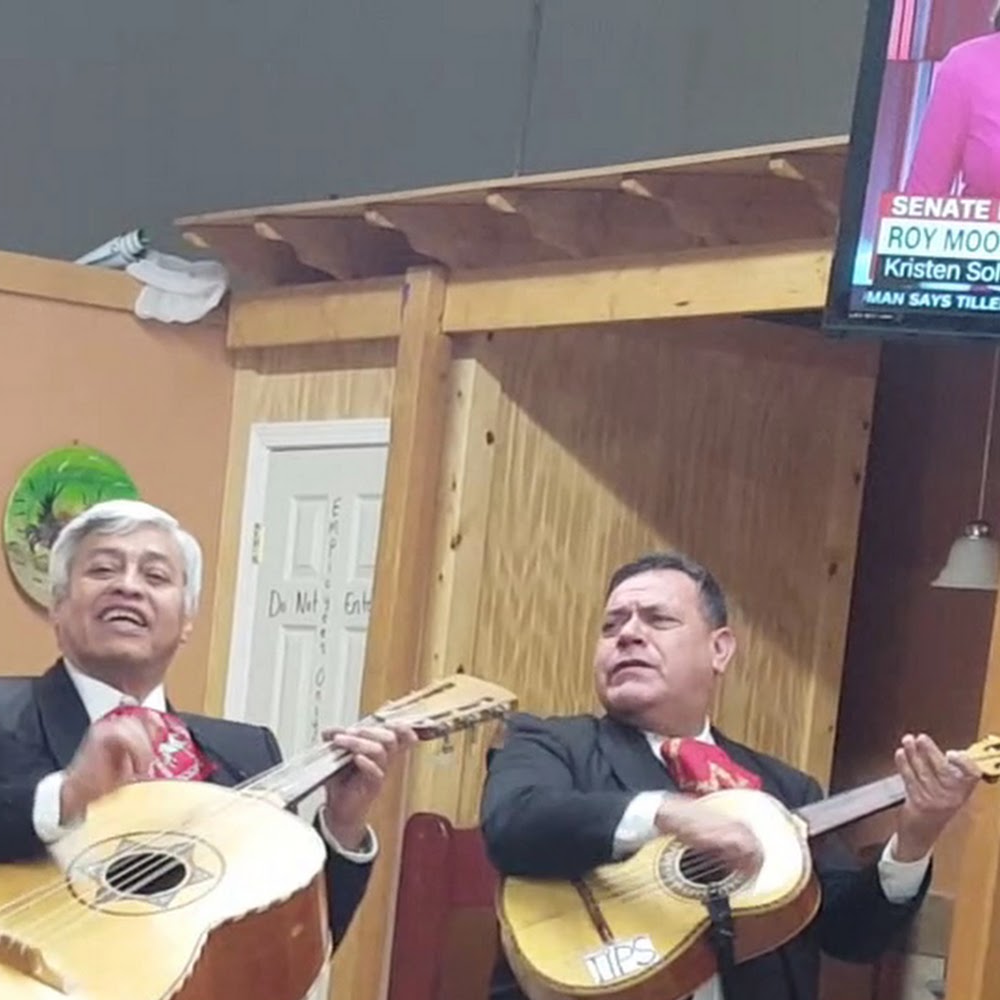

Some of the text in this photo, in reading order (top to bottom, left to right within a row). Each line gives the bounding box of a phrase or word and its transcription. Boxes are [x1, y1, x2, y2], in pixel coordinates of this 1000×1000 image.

[891, 196, 991, 220] SENATE
[888, 226, 938, 250] ROY
[884, 258, 961, 281] Kristen
[909, 293, 952, 309] SAYS
[268, 588, 371, 619] Do Not Ent
[590, 936, 657, 982] TIPS
